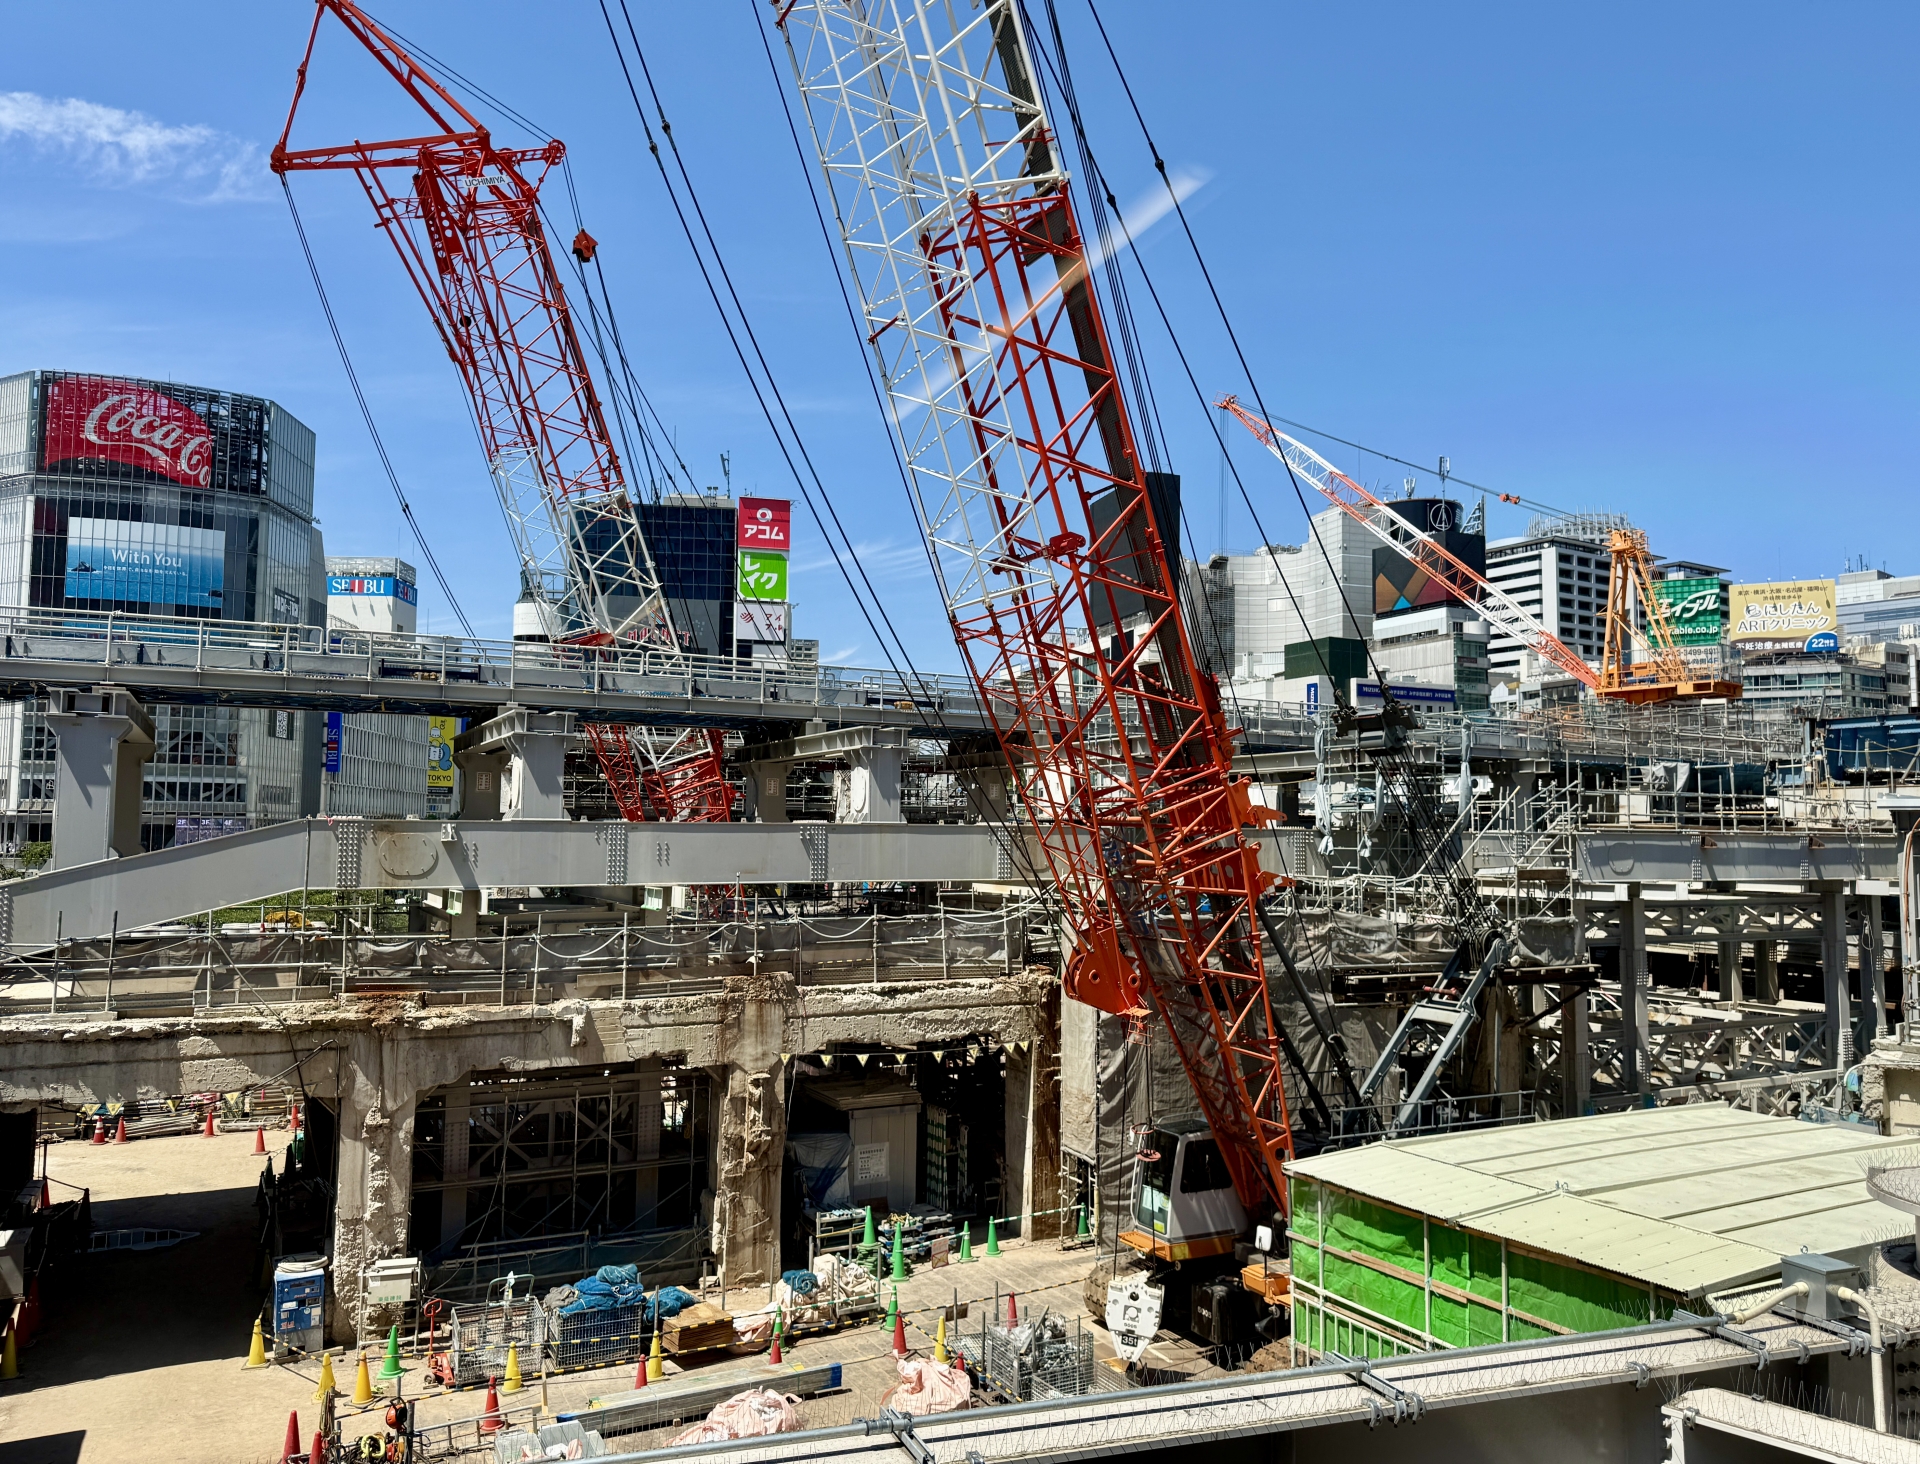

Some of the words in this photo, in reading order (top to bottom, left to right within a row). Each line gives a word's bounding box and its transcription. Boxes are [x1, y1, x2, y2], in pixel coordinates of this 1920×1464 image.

[464, 176, 506, 187] UCHIMIYA
[744, 524, 784, 540] アコム
[111, 548, 150, 565] With
[153, 552, 182, 568] You
[332, 578, 385, 594] SEIBU
[1646, 588, 1720, 620] エイブル
[1764, 602, 1820, 617] にしたん
[1737, 616, 1830, 633] ARTクリニック
[1736, 640, 1773, 651] 不妊治療
[327, 728, 339, 765] SEIBU
[428, 774, 452, 782] TOKYO
[1122, 1335, 1137, 1346] 35t
